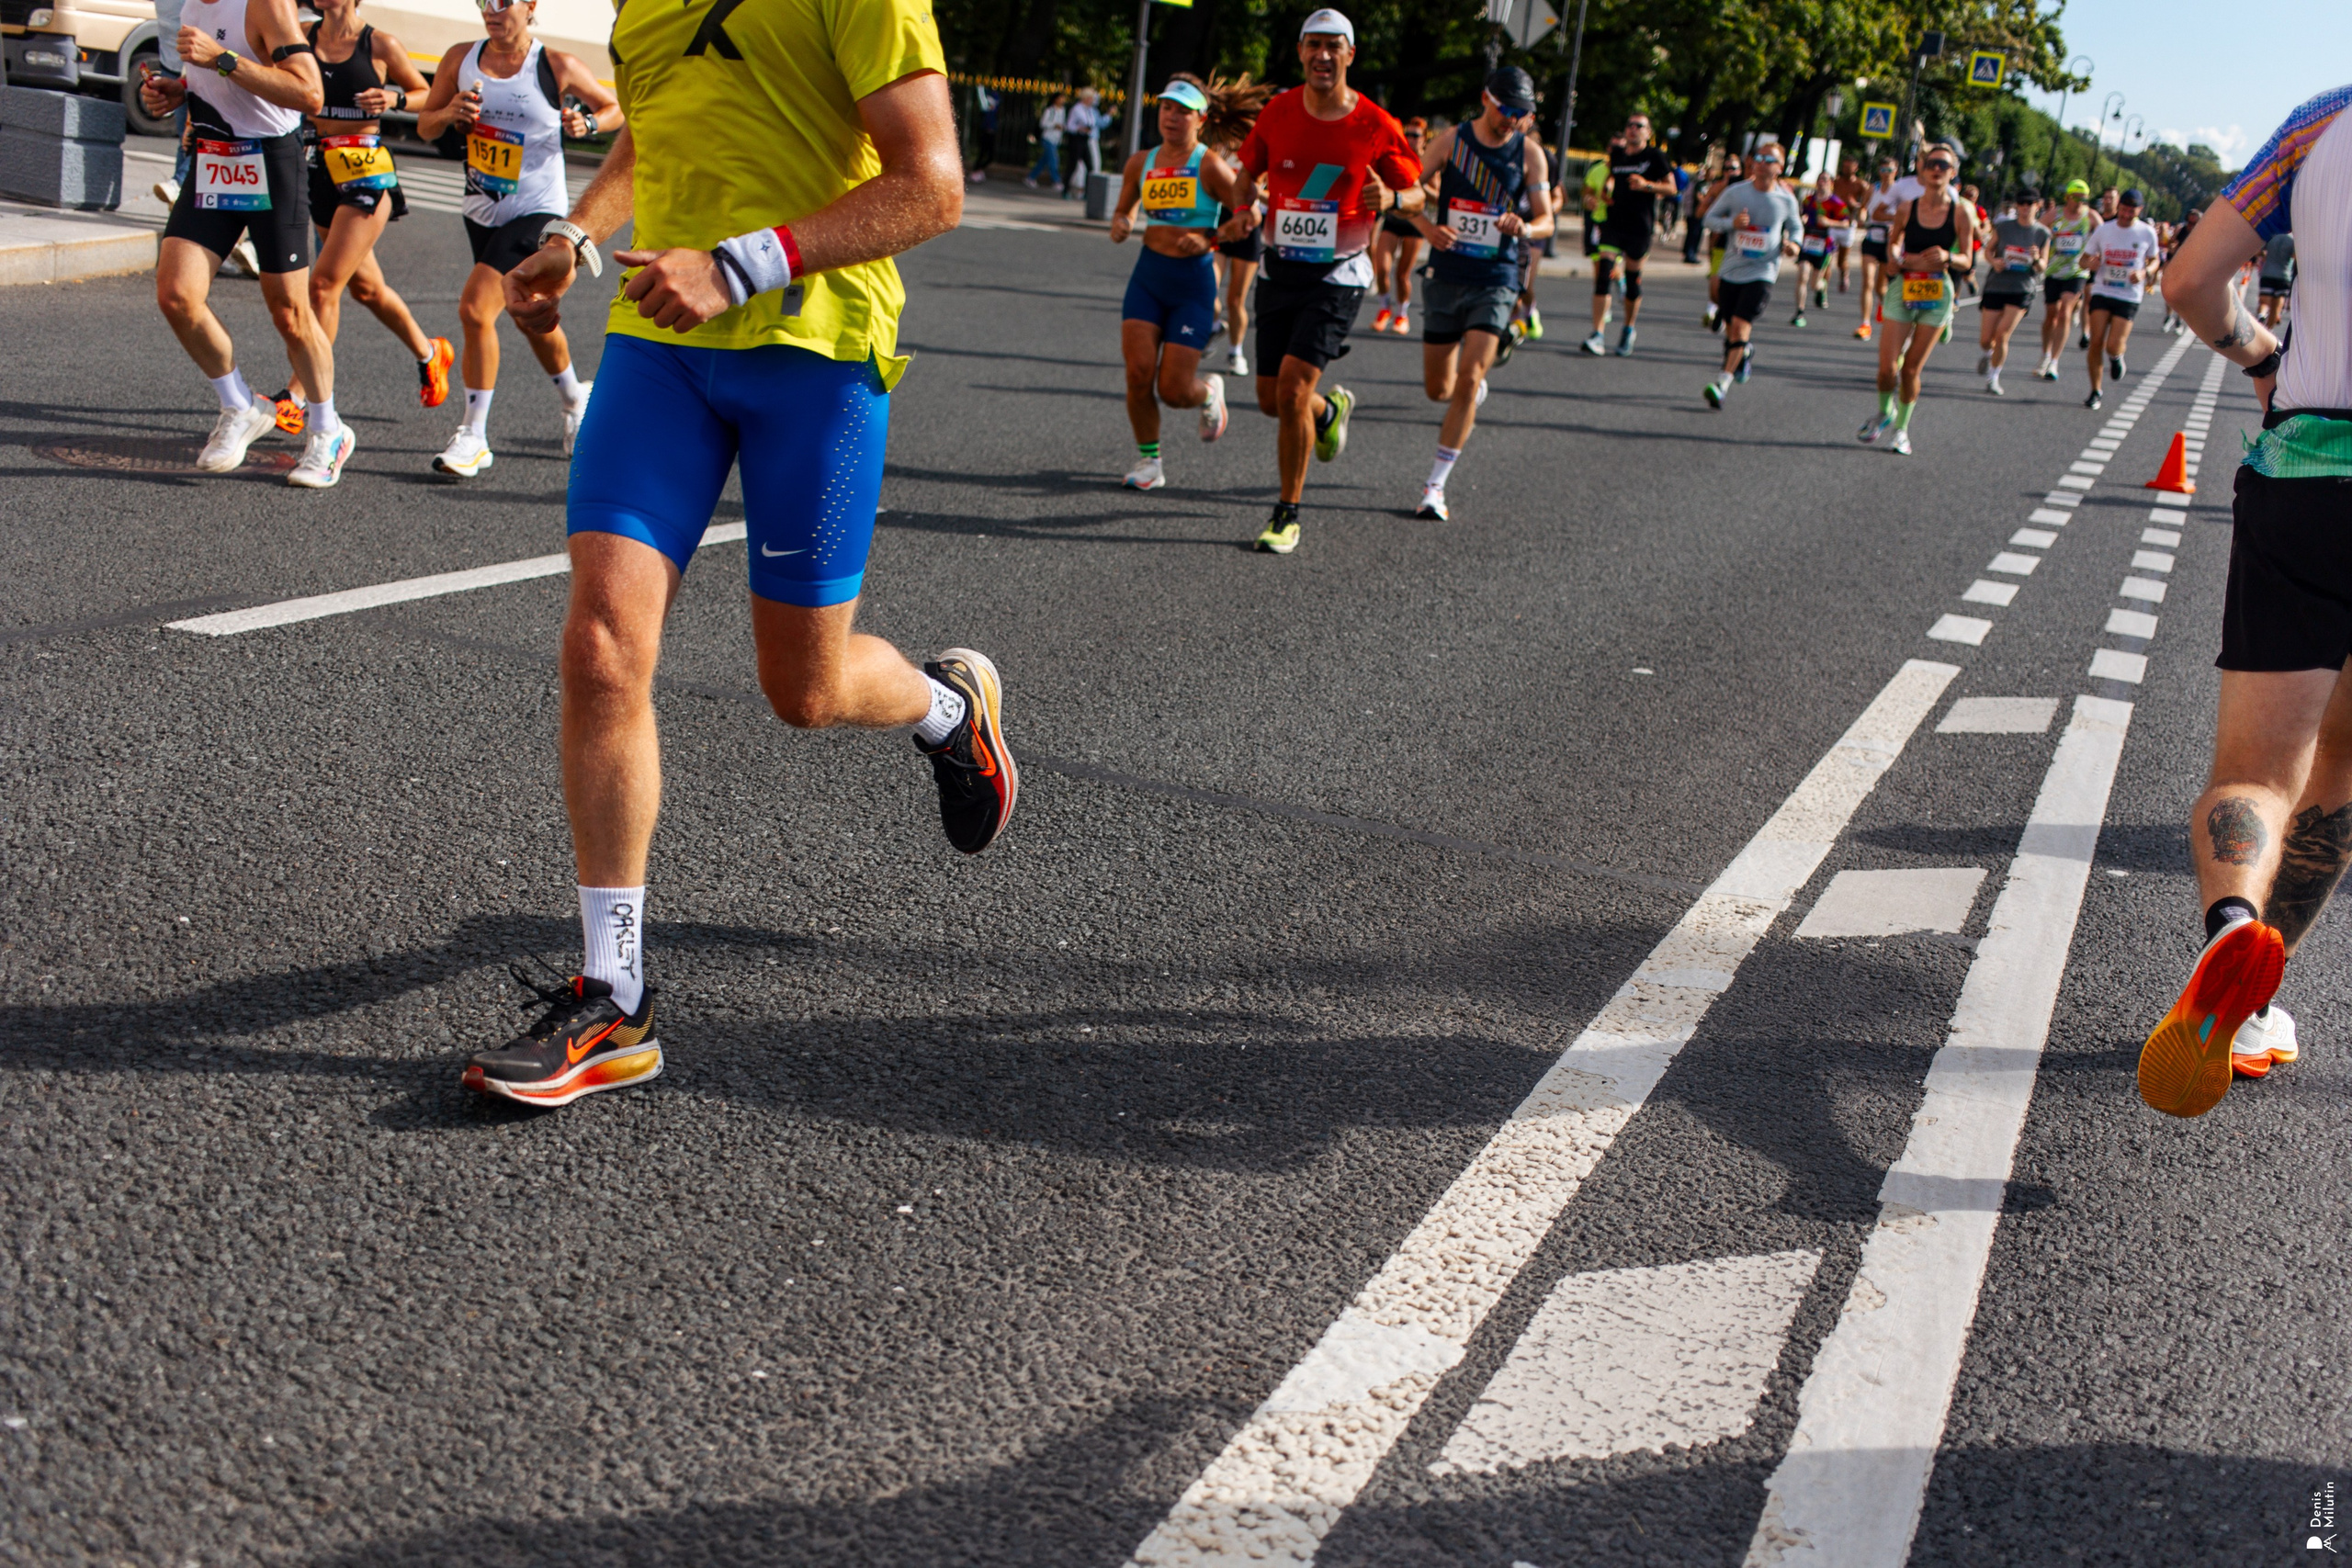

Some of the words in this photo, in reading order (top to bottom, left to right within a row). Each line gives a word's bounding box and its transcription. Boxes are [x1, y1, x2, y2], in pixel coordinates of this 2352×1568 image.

[472, 139, 511, 168] 1511
[206, 163, 259, 186] 7045
[206, 194, 215, 207] C
[1148, 181, 1189, 200] 6605
[1282, 216, 1329, 237] 6604
[1458, 215, 1488, 236] 331
[612, 902, 637, 981] OAKLEY
